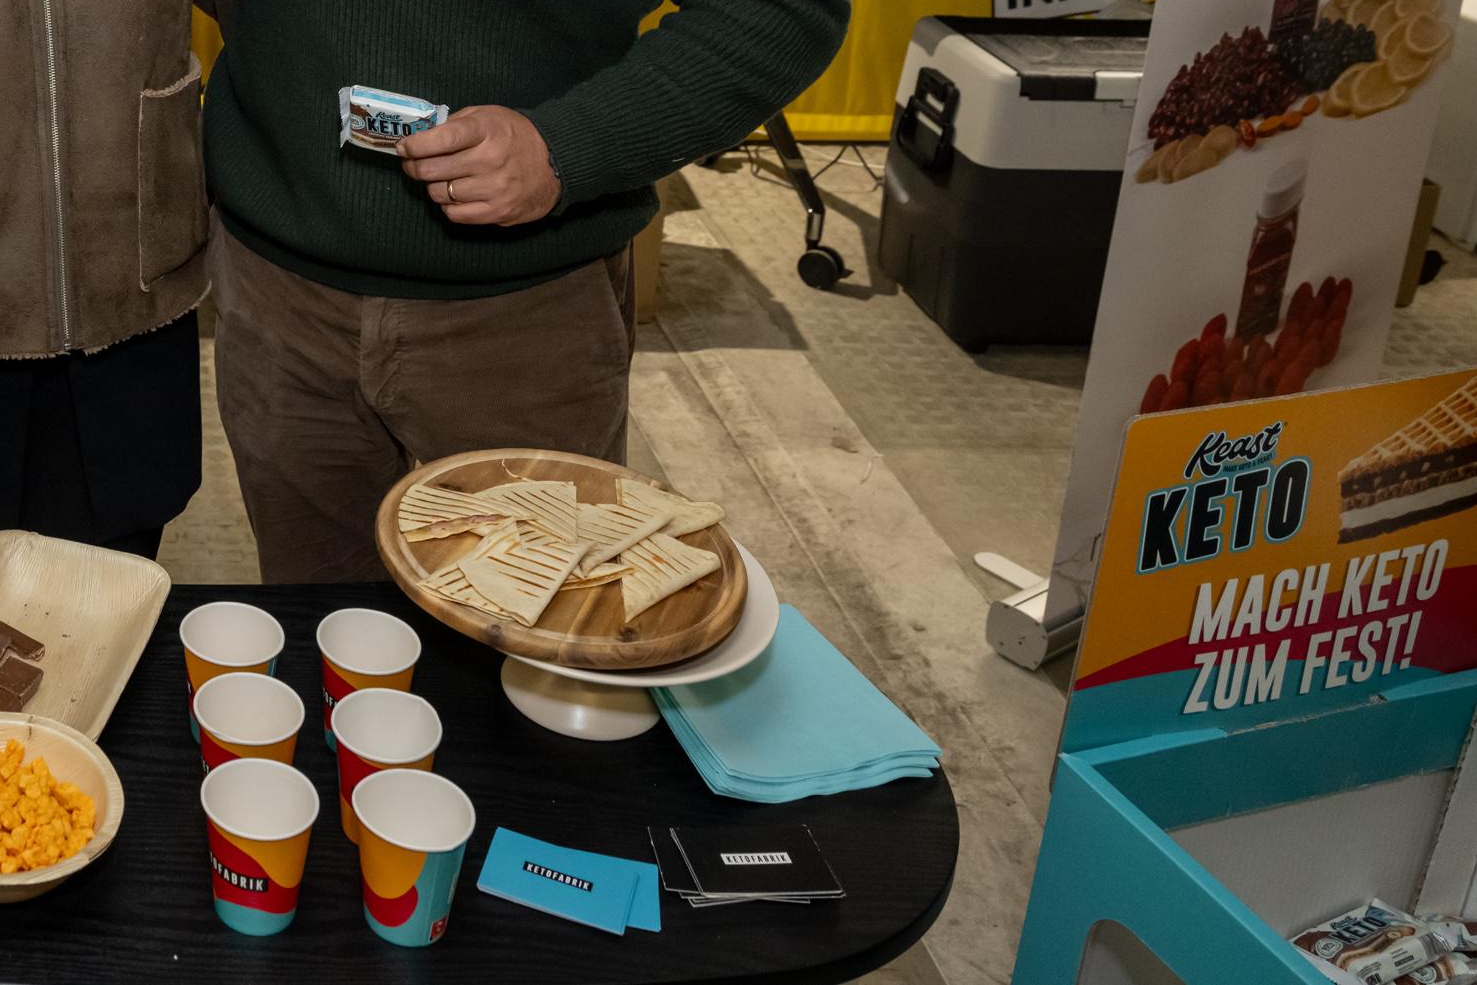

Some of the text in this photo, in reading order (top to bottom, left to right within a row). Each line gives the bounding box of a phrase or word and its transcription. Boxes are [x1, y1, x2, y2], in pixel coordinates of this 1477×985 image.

[367, 117, 412, 136] KETO
[1184, 422, 1282, 478] Keast
[1140, 460, 1310, 571] KETO
[1187, 538, 1449, 645] MACH KETO
[1183, 611, 1424, 714] ZUM FEST!
[526, 863, 590, 891] KETOFABRIK
[725, 854, 788, 864] KETOFABRIK
